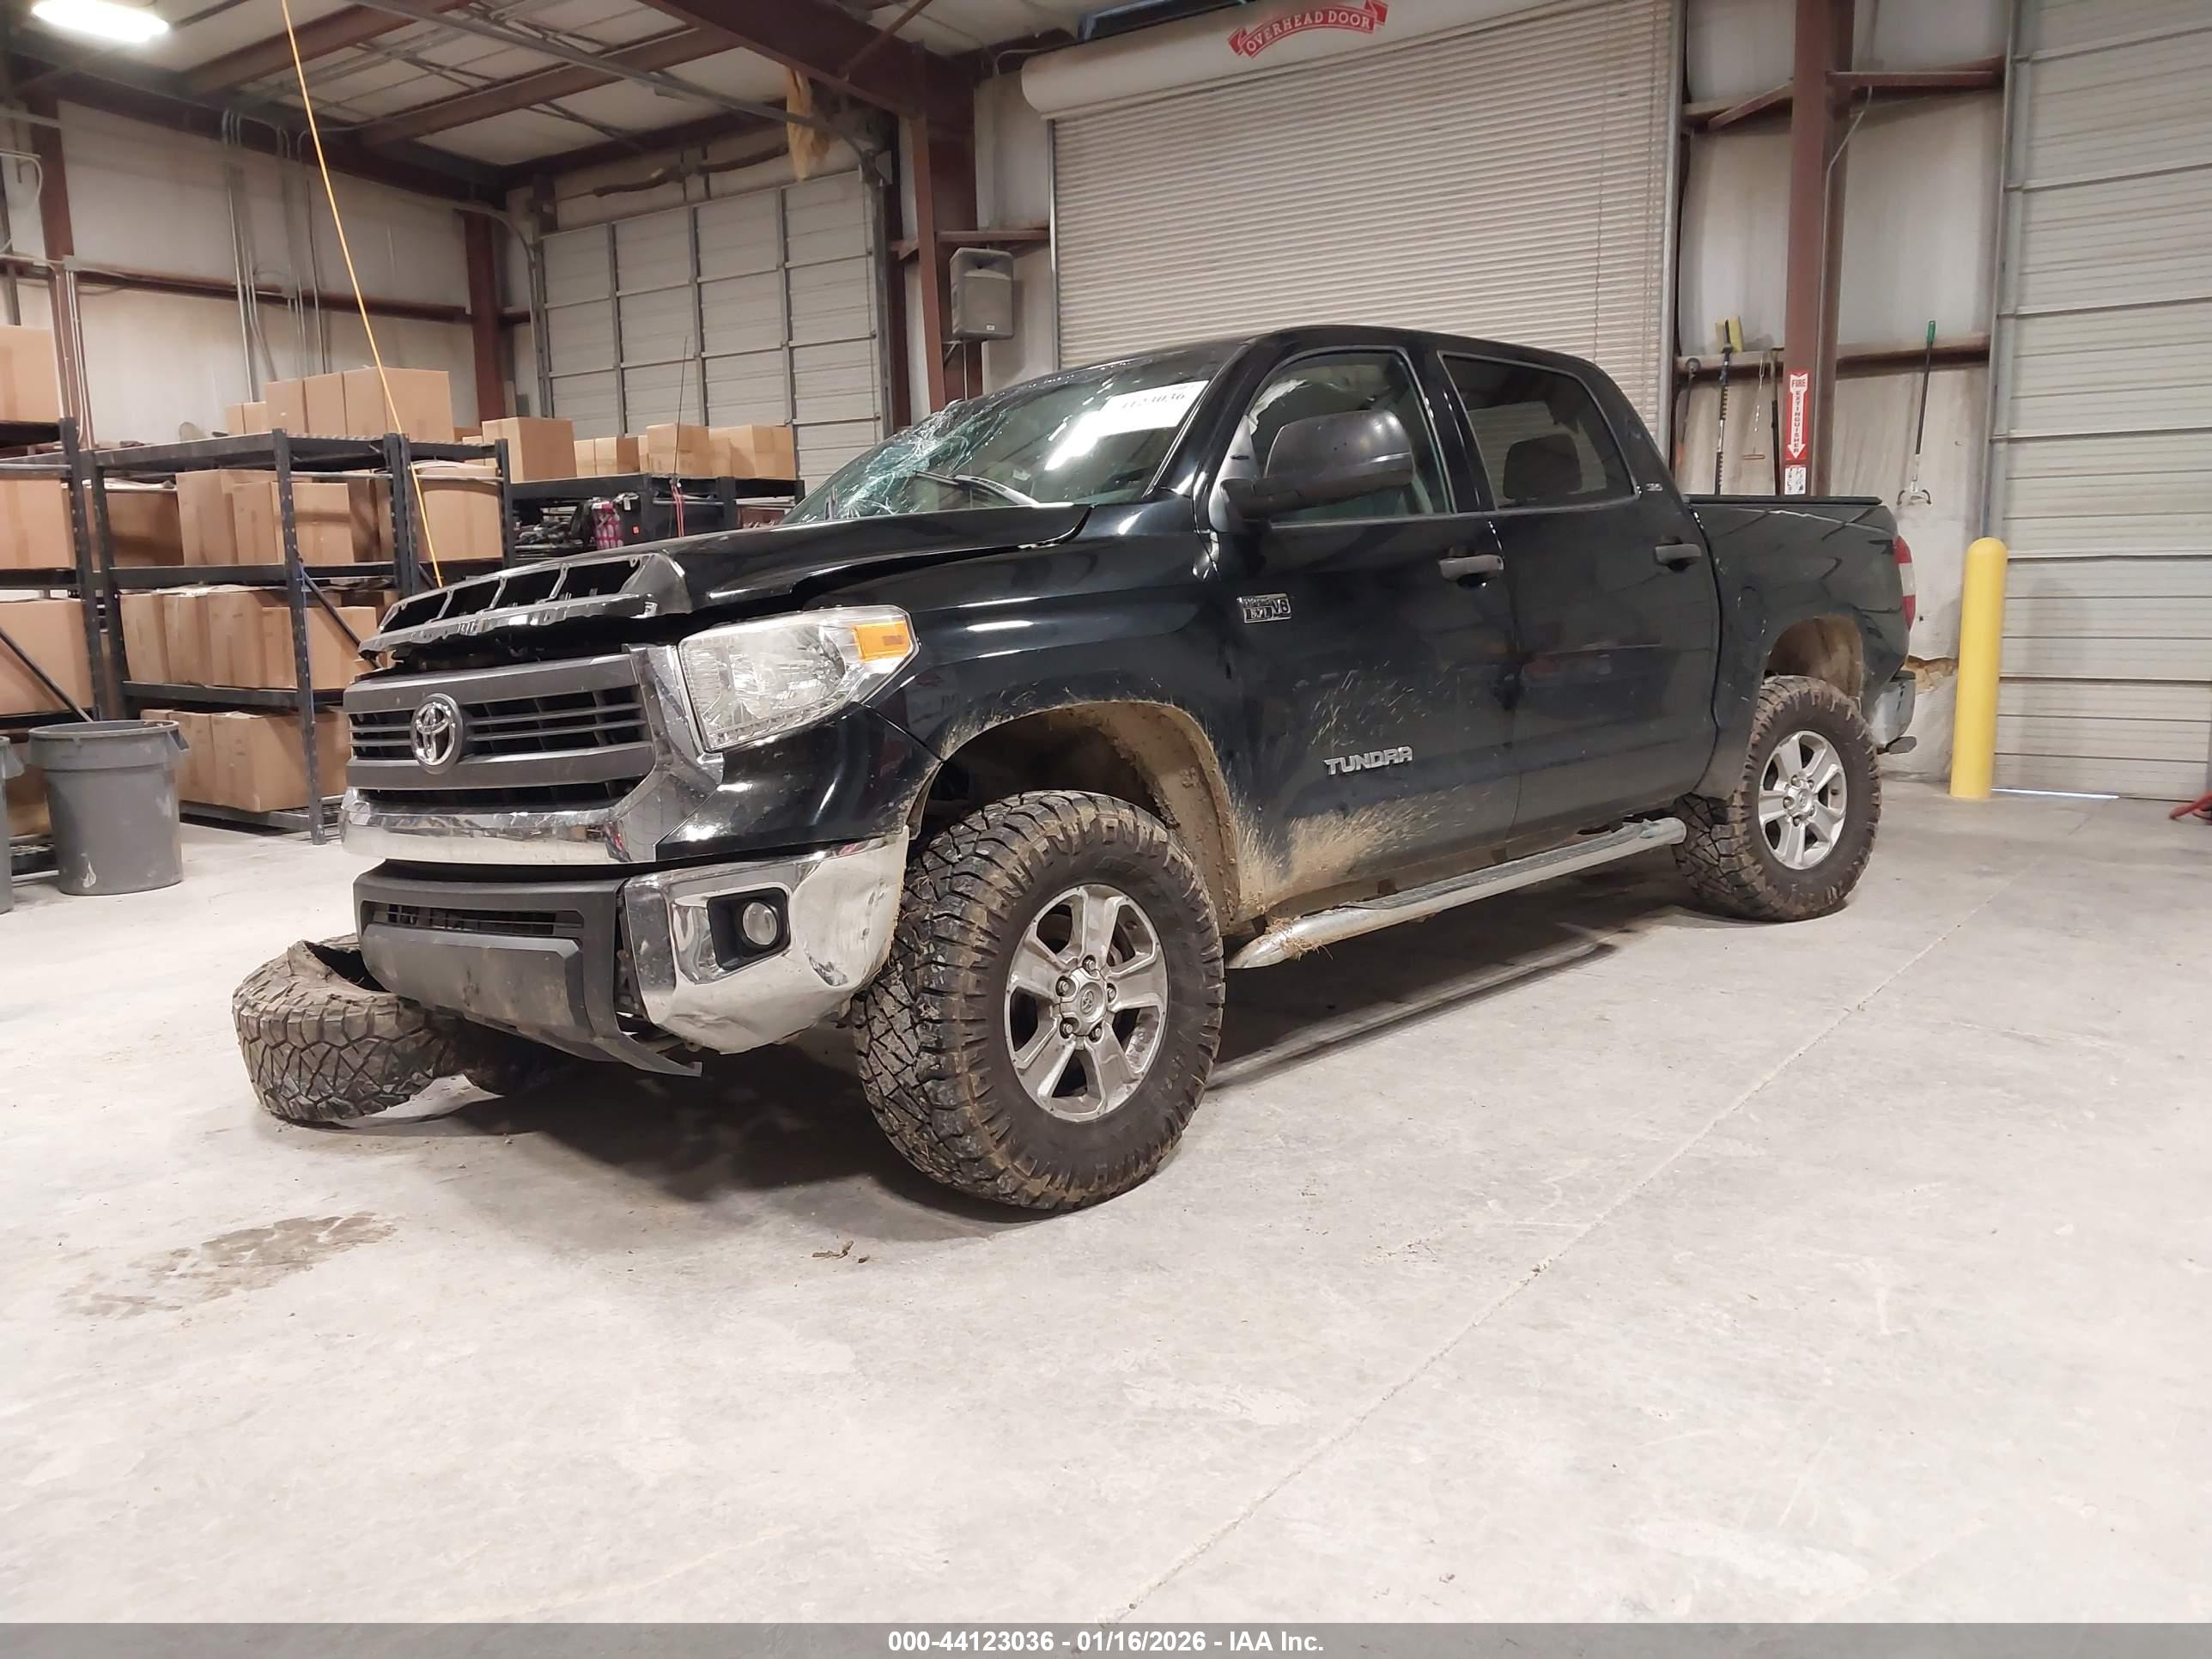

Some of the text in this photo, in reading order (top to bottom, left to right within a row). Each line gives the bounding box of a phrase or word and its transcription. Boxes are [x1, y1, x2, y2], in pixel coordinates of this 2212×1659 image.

[1246, 10, 1371, 52] OVERHEAD DOOR
[1791, 379, 1807, 387] FIRE
[1793, 390, 1802, 453] EXTINGUISHER
[1324, 745, 1413, 775] TUNDRA
